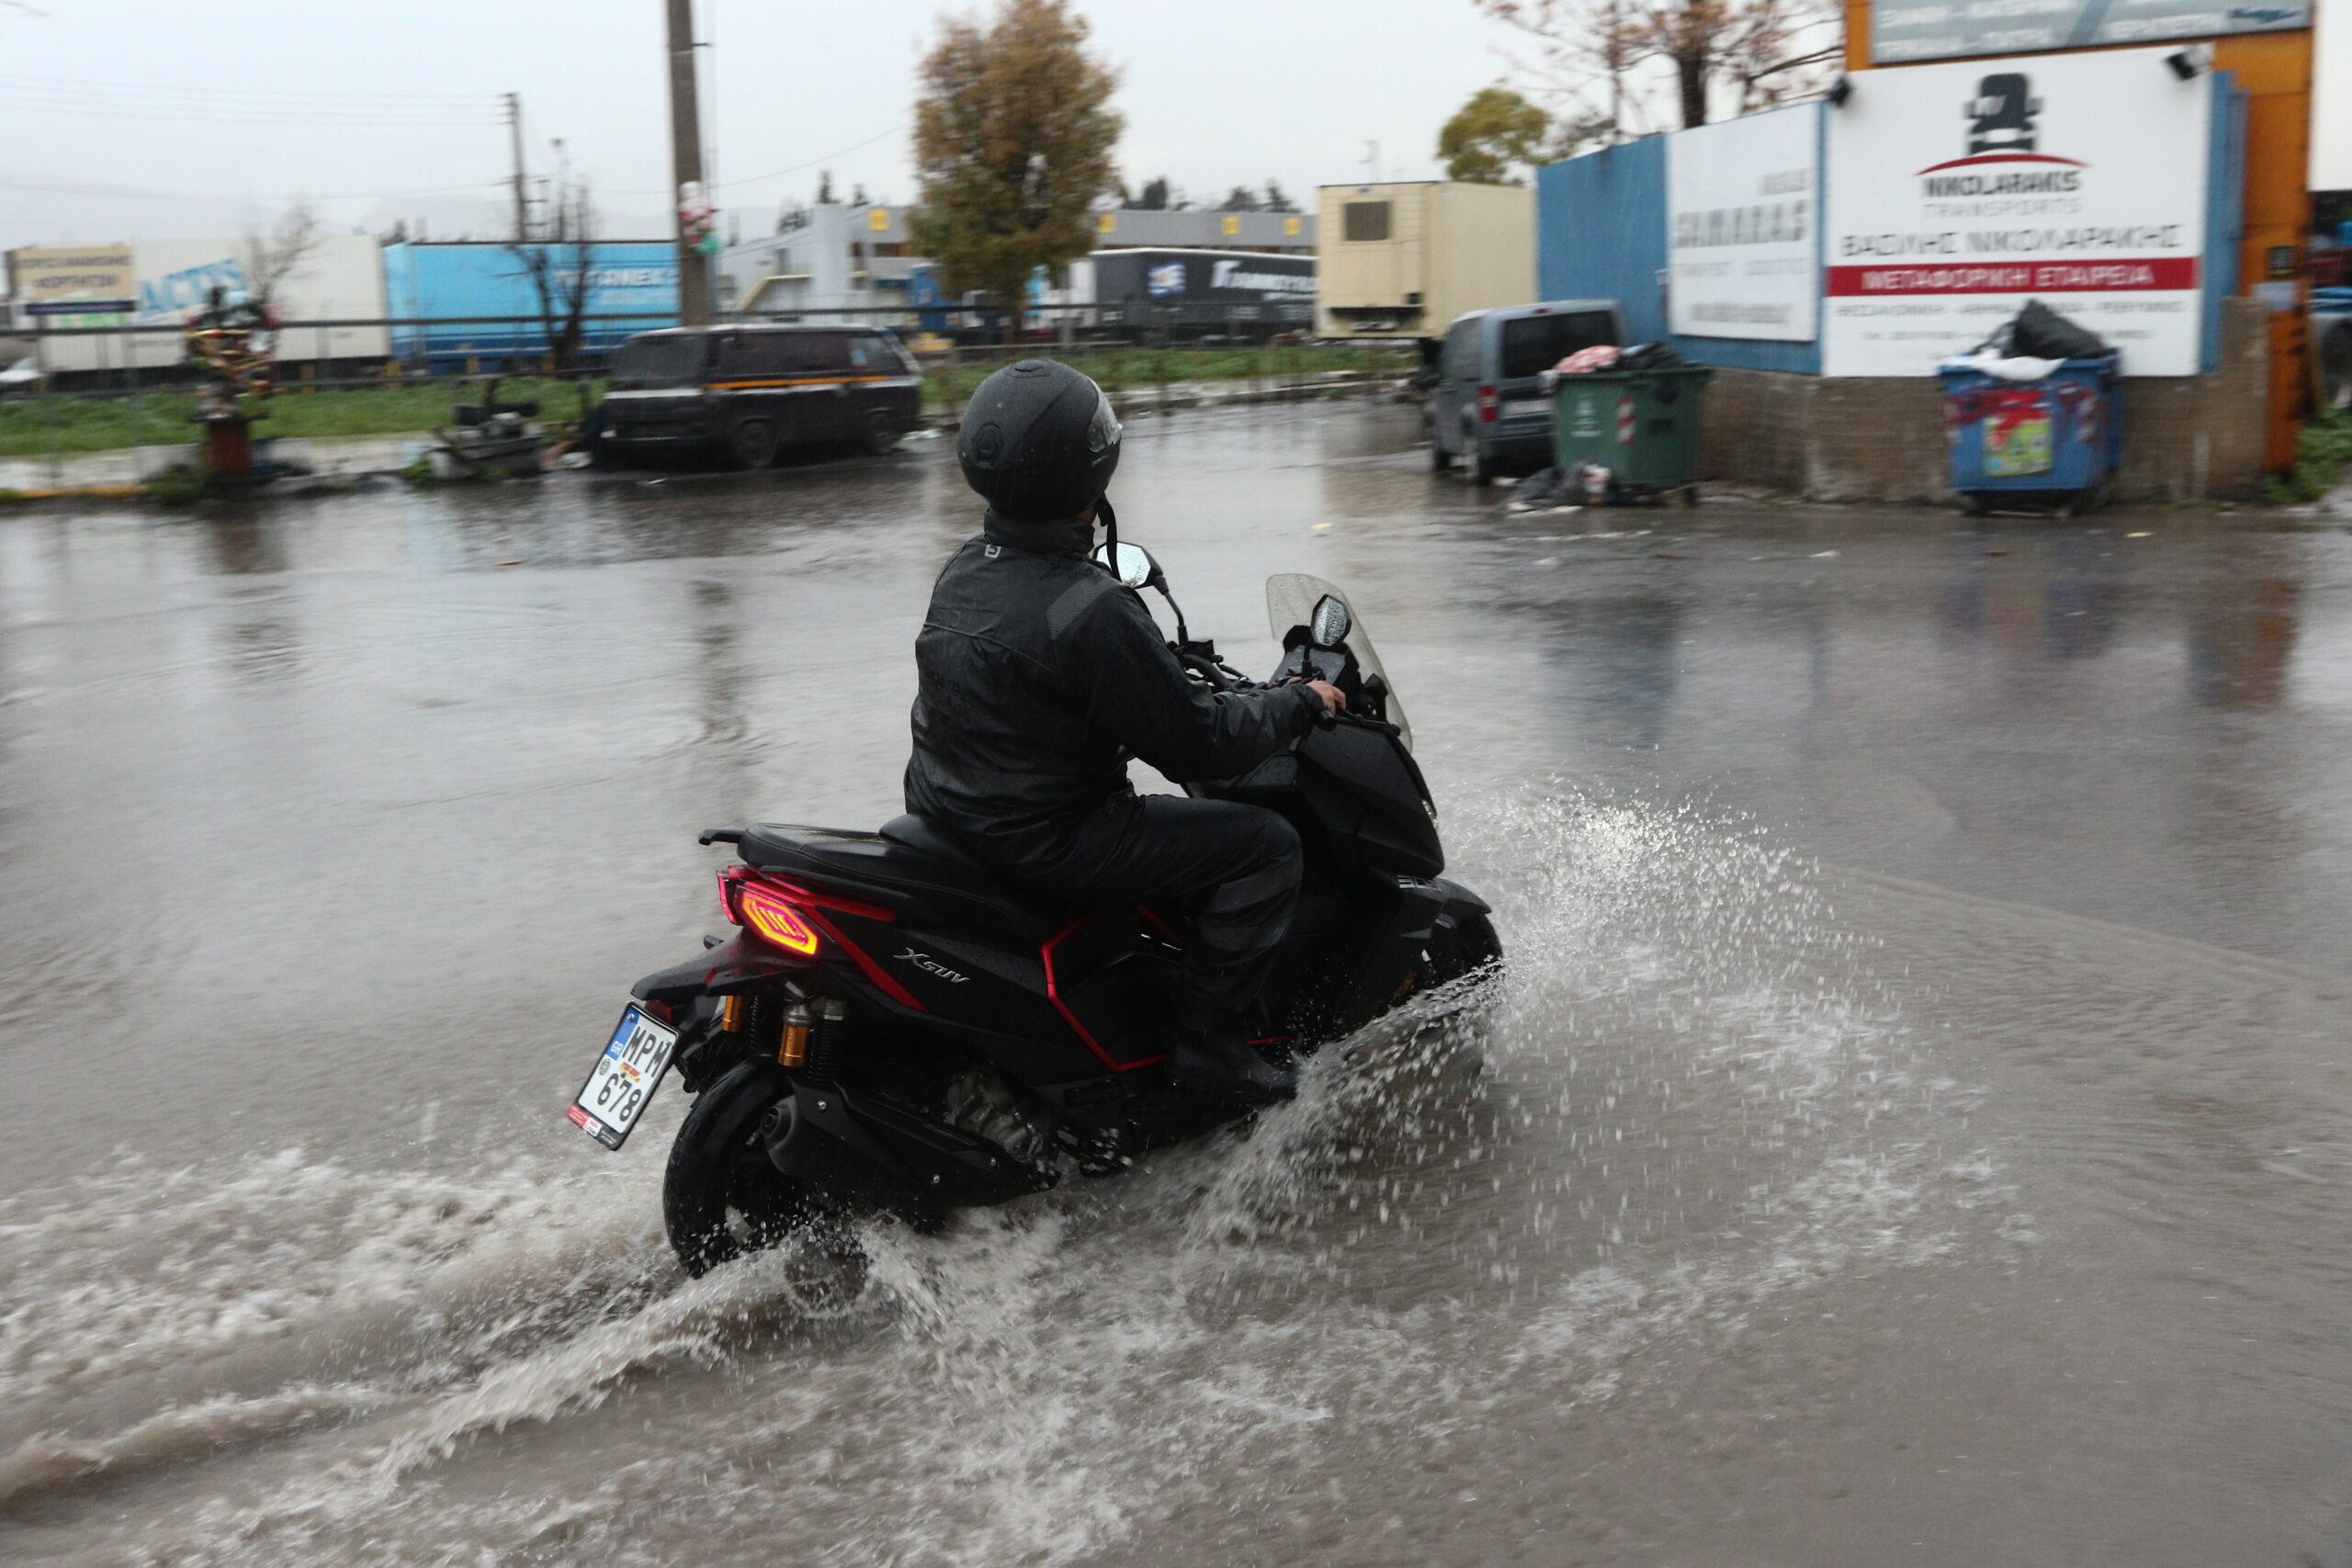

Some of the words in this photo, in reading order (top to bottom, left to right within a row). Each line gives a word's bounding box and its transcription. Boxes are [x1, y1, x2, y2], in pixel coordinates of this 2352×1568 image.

[1921, 170, 2082, 197] NIKOLARAKIS
[1921, 197, 2083, 218] TRANSPORTS
[1842, 231, 1959, 257] ΒΑΣΙΛΗΣ
[1966, 224, 2182, 254] ΝΙΚΟΛΑΡΑΚΗΣ
[1861, 267, 2031, 291] ΜΕΤΑΦΟΡΙΚΗ
[2035, 264, 2155, 288] ΕΤΑΙΡΕΙΑ
[610, 1041, 624, 1055] GR
[622, 1026, 672, 1077] MPM
[598, 1073, 642, 1122] 678
